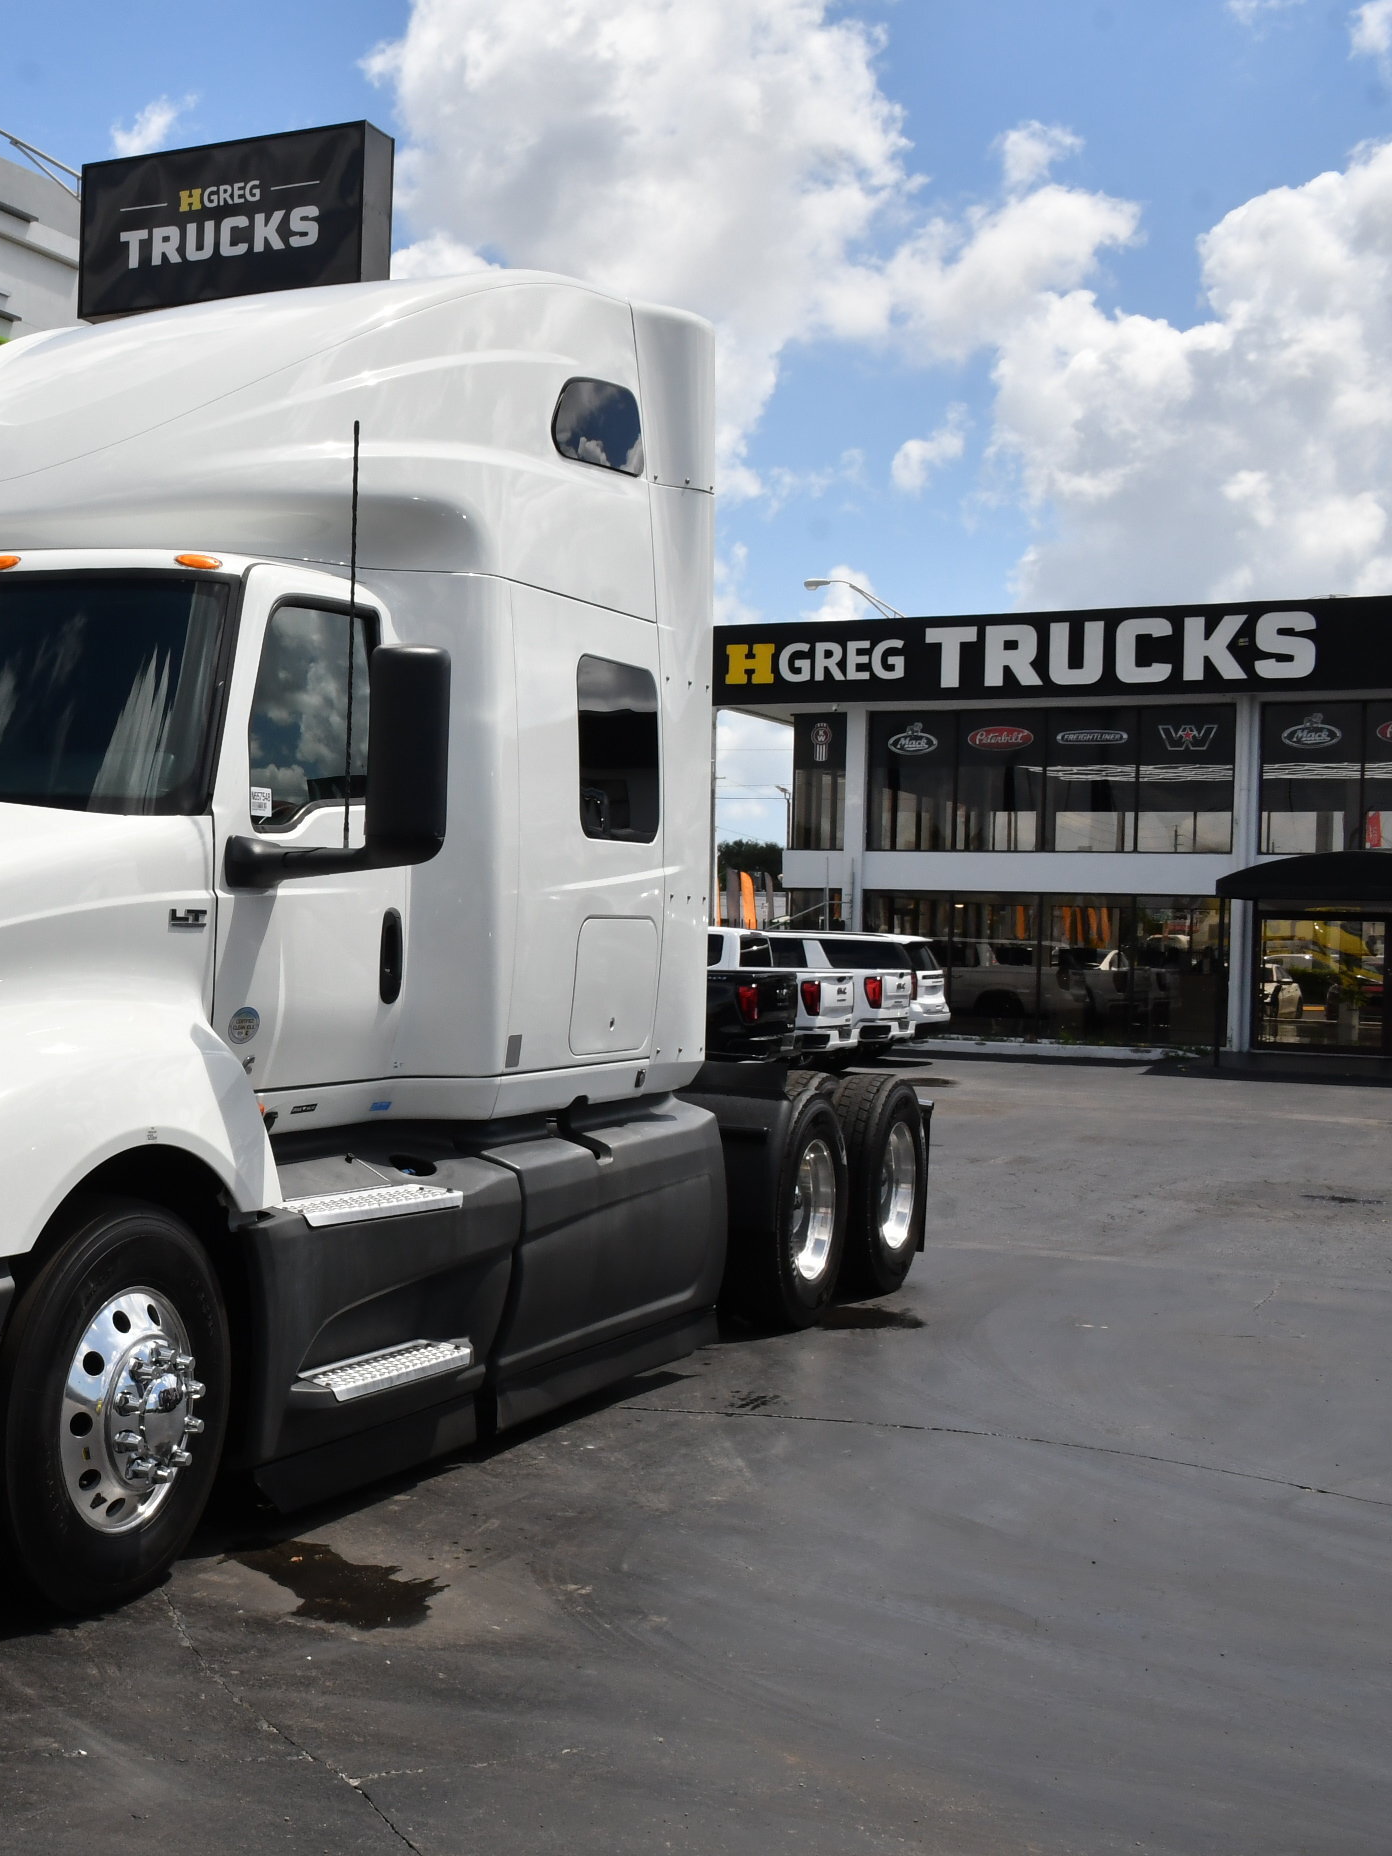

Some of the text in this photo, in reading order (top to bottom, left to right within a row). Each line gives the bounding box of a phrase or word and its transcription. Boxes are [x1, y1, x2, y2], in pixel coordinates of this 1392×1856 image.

[179, 180, 261, 212] HGREG
[120, 205, 320, 269] TRUCKS
[725, 611, 1317, 689] HGREG TRUCKS
[898, 737, 928, 749] Mack
[976, 731, 1027, 744] Peterbilt
[1292, 729, 1331, 743] Mack
[169, 909, 207, 923] LT
